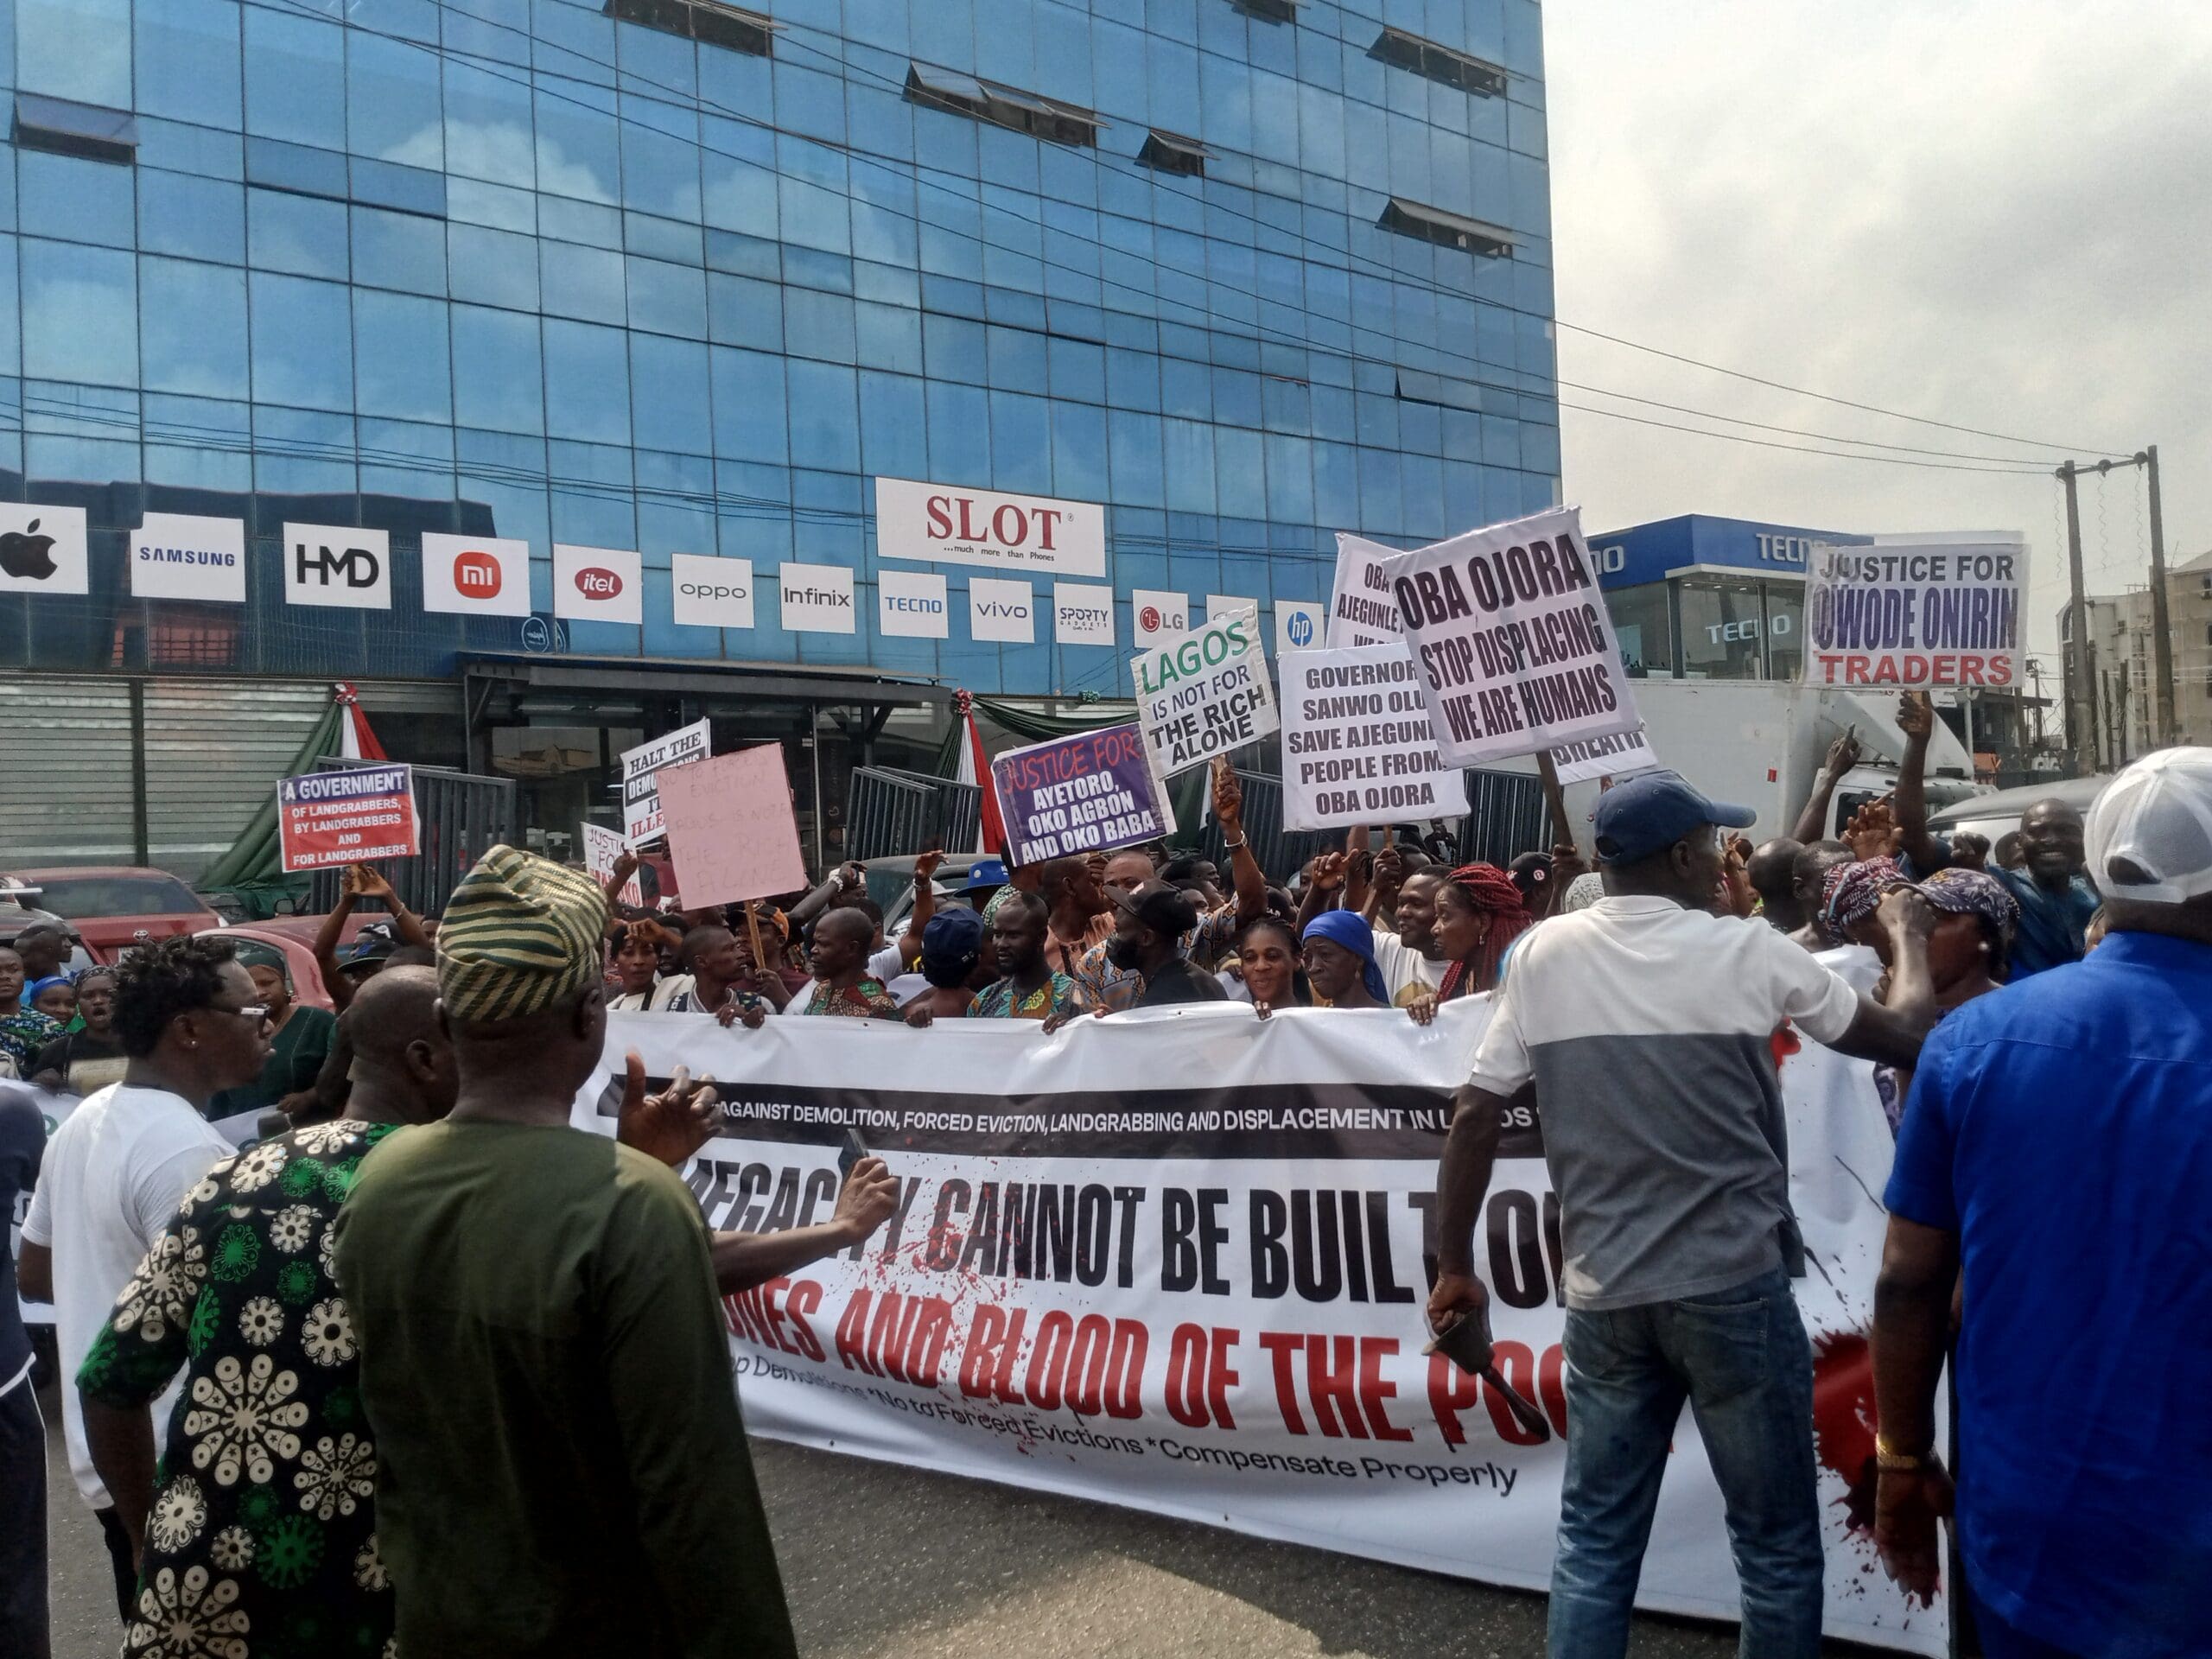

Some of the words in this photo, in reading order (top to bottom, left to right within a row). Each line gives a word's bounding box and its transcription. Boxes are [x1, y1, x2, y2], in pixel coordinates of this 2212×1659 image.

[927, 496, 1061, 550] SLOT
[140, 547, 235, 567] SAMSUNG
[1030, 552, 1054, 562] Phones
[1756, 533, 1813, 562] TECN
[296, 543, 379, 588] HMD
[1395, 565, 1473, 631] OBA
[1468, 533, 1592, 613] OJORA
[1820, 553, 1946, 582] JUSTICE
[1956, 556, 2014, 582] FOR
[583, 573, 615, 594] itel
[784, 587, 849, 607] Infinix
[886, 596, 942, 613] TECNO
[976, 601, 1027, 619] vivo
[1060, 607, 1108, 621] SPORTY
[1162, 613, 1183, 630] LG
[1337, 593, 1398, 632] AJEGUNLE
[1812, 583, 1916, 651] OWODE
[1923, 587, 2018, 650] ONIRIN
[1291, 614, 1310, 644] hp
[1141, 621, 1248, 696] LAGOS
[1420, 636, 1474, 691] STOP
[1472, 603, 1607, 679] DISPLACING
[1818, 655, 2012, 686] TRADERS
[1153, 700, 1167, 721] IS
[1172, 681, 1205, 713] NOT
[1212, 664, 1251, 696] FOR
[1303, 694, 1382, 721] SANWO
[1389, 690, 1427, 713] OLU
[1441, 694, 1483, 743] WE
[1478, 683, 1524, 736] ARE
[1516, 663, 1618, 728] HUMANS
[1148, 713, 1199, 749] THE
[1203, 683, 1267, 729] RICH
[630, 747, 666, 775] HALT
[670, 731, 701, 757] THE
[1172, 714, 1255, 766] ALONE
[1288, 730, 1342, 754] SAVE
[1346, 719, 1435, 749] AJEGUN
[1004, 743, 1089, 795] JUSTICE
[1093, 732, 1141, 770] FOR
[1300, 756, 1376, 785] PEOPLE
[1382, 750, 1443, 776] FROM
[285, 782, 296, 801] A
[299, 772, 404, 799] GOVERNMENT
[1033, 771, 1120, 811] AYETORO,
[1316, 788, 1361, 816] OBA
[1365, 783, 1435, 810] OJORA
[292, 807, 307, 818] OF
[309, 798, 402, 817] LANDGRABBERS,
[294, 823, 308, 834] BY
[313, 813, 401, 832] LANDGRABBERS
[1028, 808, 1067, 837] OKO
[1071, 790, 1136, 827] AGBON
[338, 833, 361, 846] AND
[588, 830, 626, 853] JUSTI
[631, 812, 665, 839] ILLE
[1020, 836, 1059, 865] AND
[1060, 824, 1101, 854] OKO
[1102, 810, 1157, 842] BABA
[293, 855, 315, 866] FOR
[318, 844, 407, 863] LANDGRABBERS
[598, 850, 614, 871] FO
[719, 1101, 791, 1121] AGAINST
[793, 1105, 900, 1131] DEMOLITION,
[903, 1111, 973, 1131] FORCED
[976, 1115, 1049, 1136] EVICTION,
[1050, 1112, 1184, 1133] LANDGRABBING
[1186, 1111, 1220, 1131] AND
[1224, 1108, 1404, 1131] DISPLACEMENT
[1409, 1109, 1436, 1130] IN
[1439, 1106, 1533, 1130] LOS
[679, 1159, 923, 1264] EGACY
[923, 1178, 1147, 1288] CANNOT
[1160, 1187, 1230, 1296] BE
[721, 1276, 826, 1363] ONES
[836, 1286, 953, 1389] AND
[957, 1304, 1149, 1420] BLOOD
[1164, 1322, 1240, 1431] OF
[1259, 1332, 1415, 1443] THE
[1427, 1339, 1567, 1447] POO
[753, 1355, 867, 1400] Demolitions
[909, 1397, 934, 1417] to
[935, 1402, 1024, 1435] Forced
[1027, 1420, 1144, 1455] Evictions
[1359, 1457, 1518, 1497] Properly
